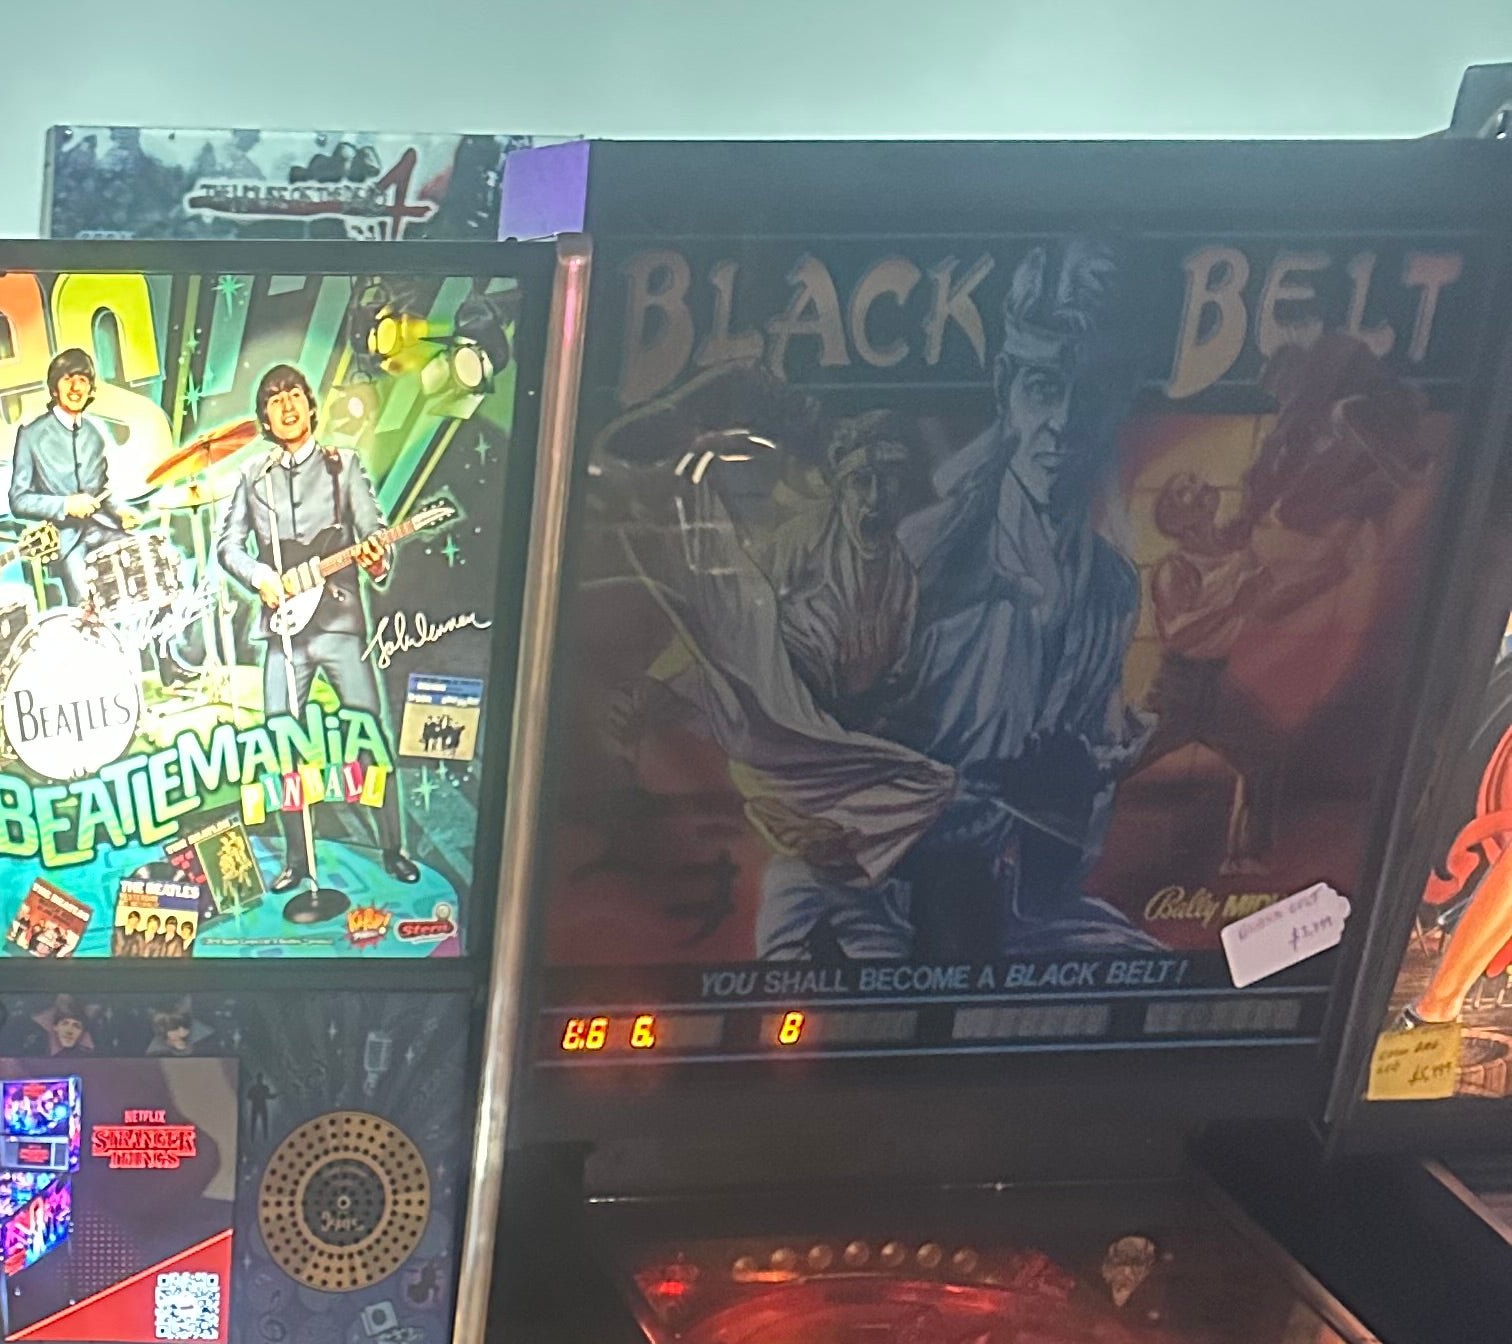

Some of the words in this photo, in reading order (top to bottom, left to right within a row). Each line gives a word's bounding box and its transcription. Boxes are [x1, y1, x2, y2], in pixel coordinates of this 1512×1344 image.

[617, 248, 996, 404] BLACK
[1168, 247, 1466, 400] BELT
[14, 689, 132, 743] BEATLES
[242, 763, 387, 824] PINBALL
[120, 880, 145, 894] THE
[145, 881, 201, 900] BEATLES
[1143, 885, 1221, 929] Bally
[400, 923, 451, 938] Stern
[700, 970, 757, 996] YOU
[763, 968, 849, 994] SHALL
[858, 964, 972, 992] BECOME
[976, 965, 997, 990] A
[1004, 961, 1099, 989] BLACK
[1105, 958, 1189, 985] BELT!
[124, 1109, 166, 1124] NETFLIX
[92, 1126, 197, 1156] STRANGER
[108, 1150, 180, 1169] THINGS
